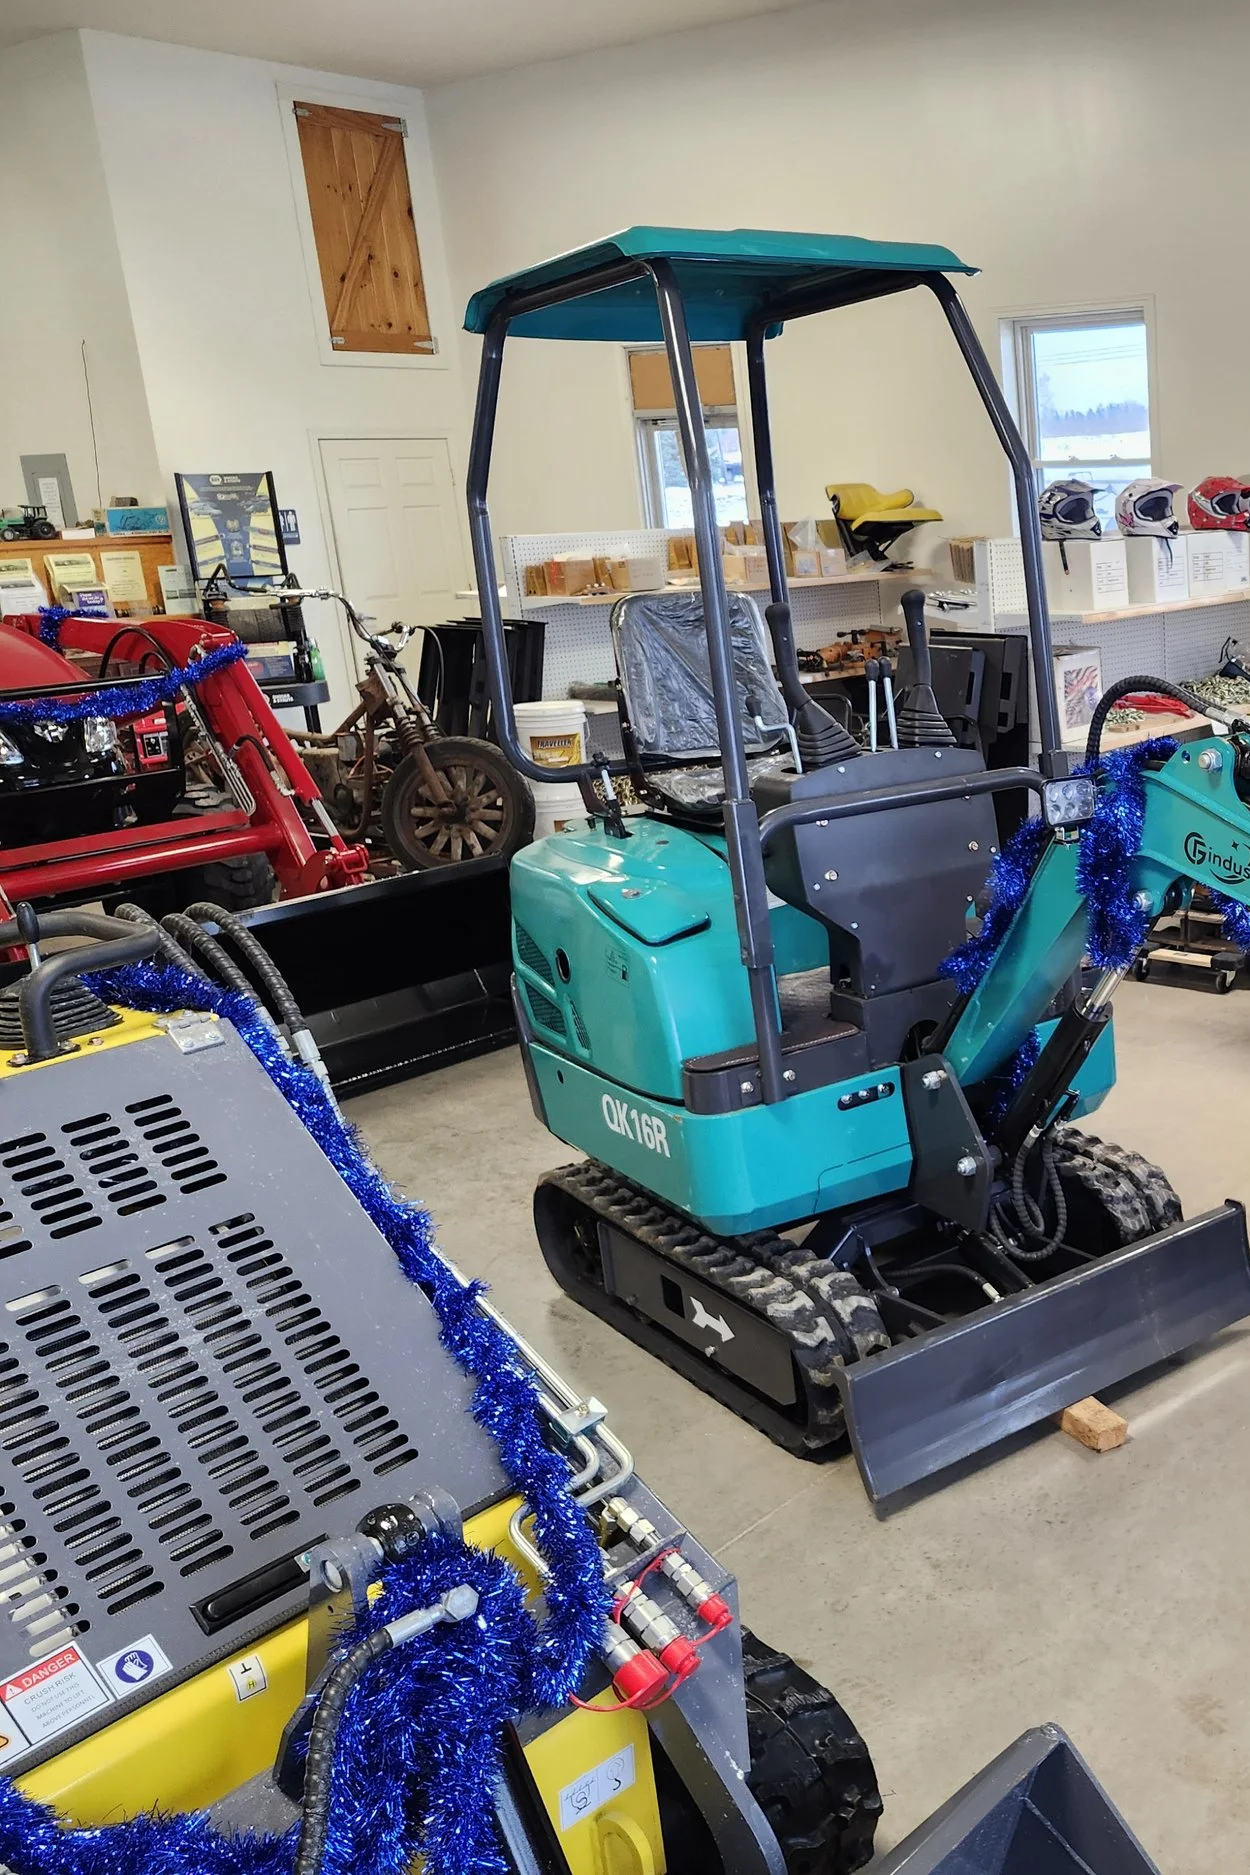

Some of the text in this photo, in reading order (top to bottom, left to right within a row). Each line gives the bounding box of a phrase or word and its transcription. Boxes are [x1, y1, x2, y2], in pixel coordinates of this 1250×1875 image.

[537, 739, 572, 749] TRAVELLER
[602, 1094, 671, 1158] QK16R
[21, 1652, 76, 1688] DANGER
[24, 1672, 76, 1705] CRUSH RISK
[31, 1682, 80, 1713] DO NOT USE THIS
[36, 1702, 64, 1720] MACHINE
[73, 1689, 85, 1699] LIFT
[42, 1694, 96, 1728] ABOVE PERSONNEL
